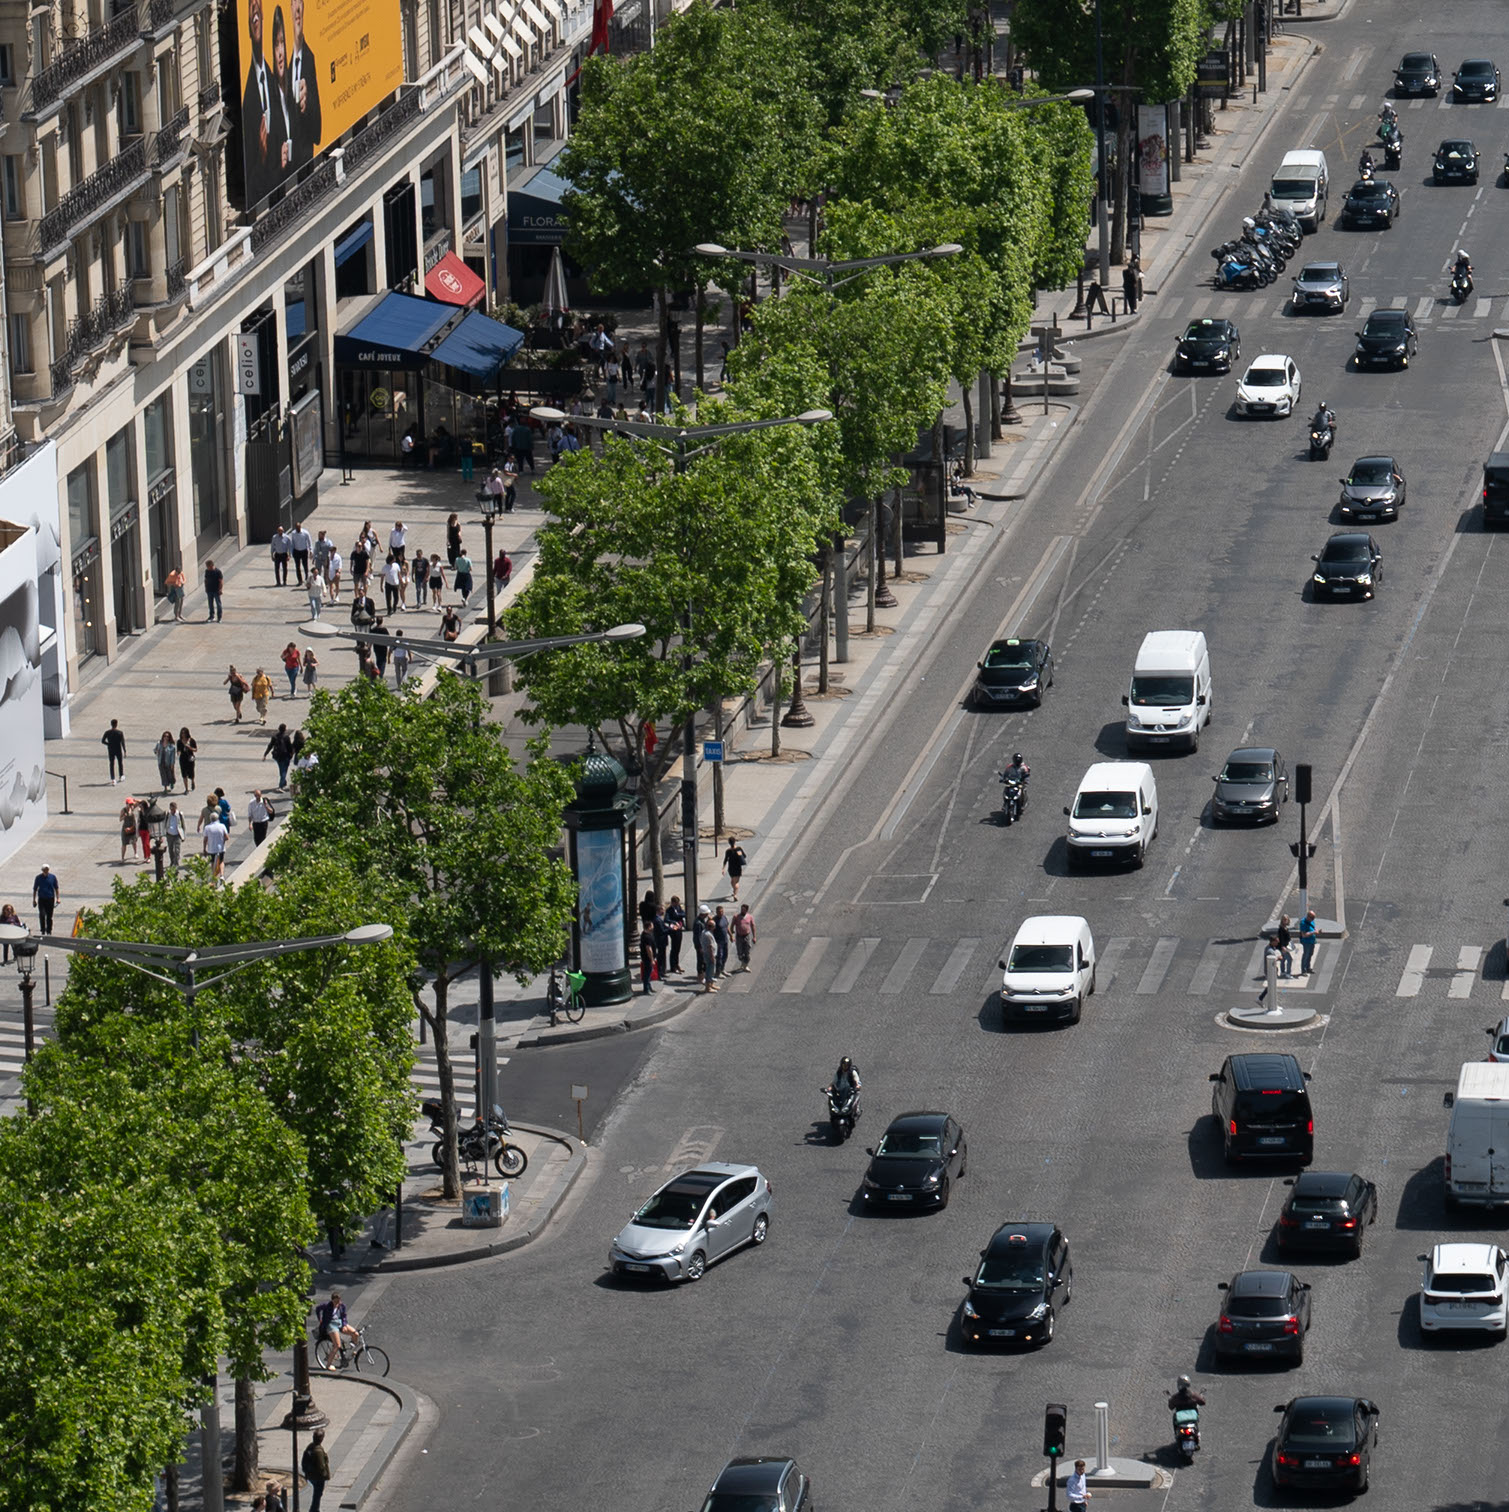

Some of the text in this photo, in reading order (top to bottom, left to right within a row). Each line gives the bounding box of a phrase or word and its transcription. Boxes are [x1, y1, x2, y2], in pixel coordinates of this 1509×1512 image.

[358, 350, 401, 362] CAFÉ JOYEUX
[242, 349, 254, 388] celio
[705, 747, 722, 755] TAXIS
